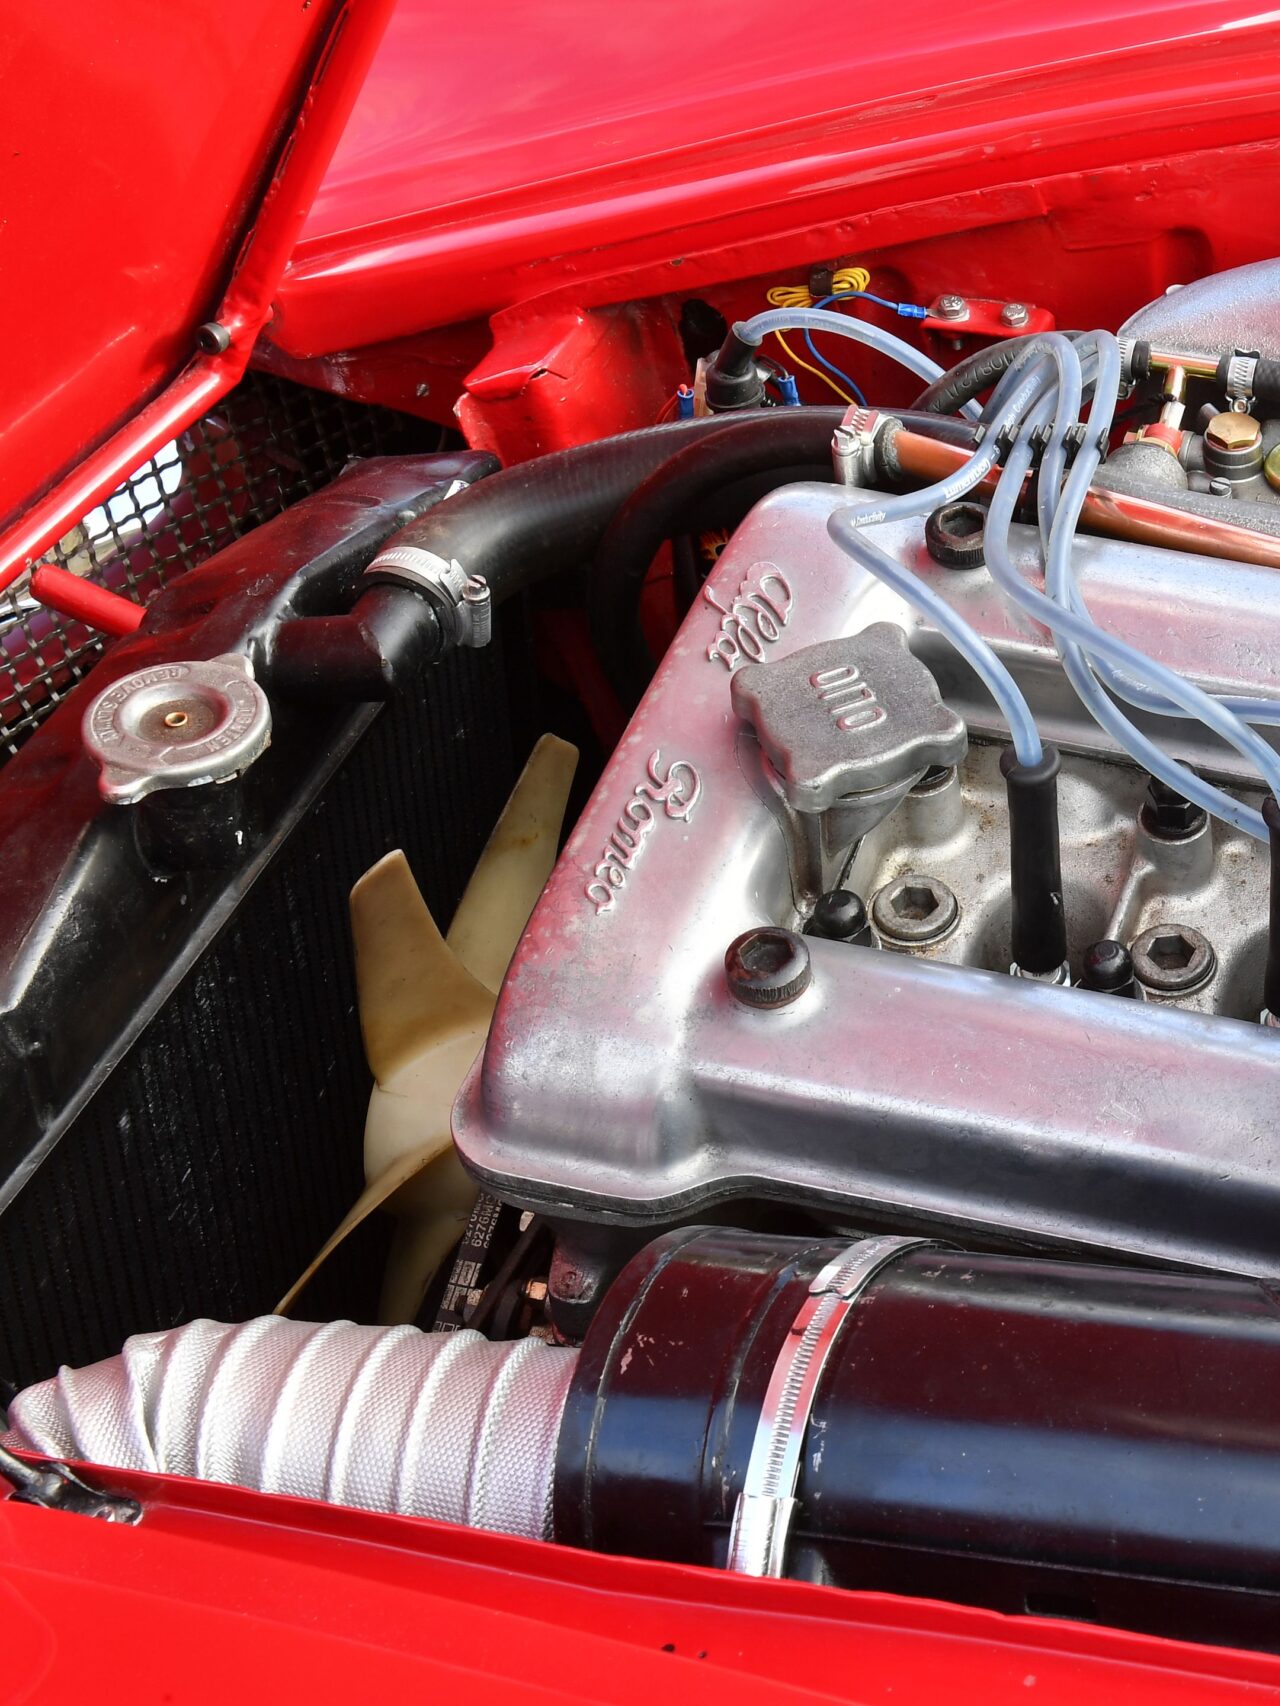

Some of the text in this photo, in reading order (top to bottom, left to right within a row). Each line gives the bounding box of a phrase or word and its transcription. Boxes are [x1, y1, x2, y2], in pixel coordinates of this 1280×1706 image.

[704, 561, 793, 671] Alfa
[111, 667, 183, 701] REMOVE
[809, 664, 887, 732] OLIO
[205, 706, 256, 752] TIGHTEN
[585, 750, 702, 915] Romeo
